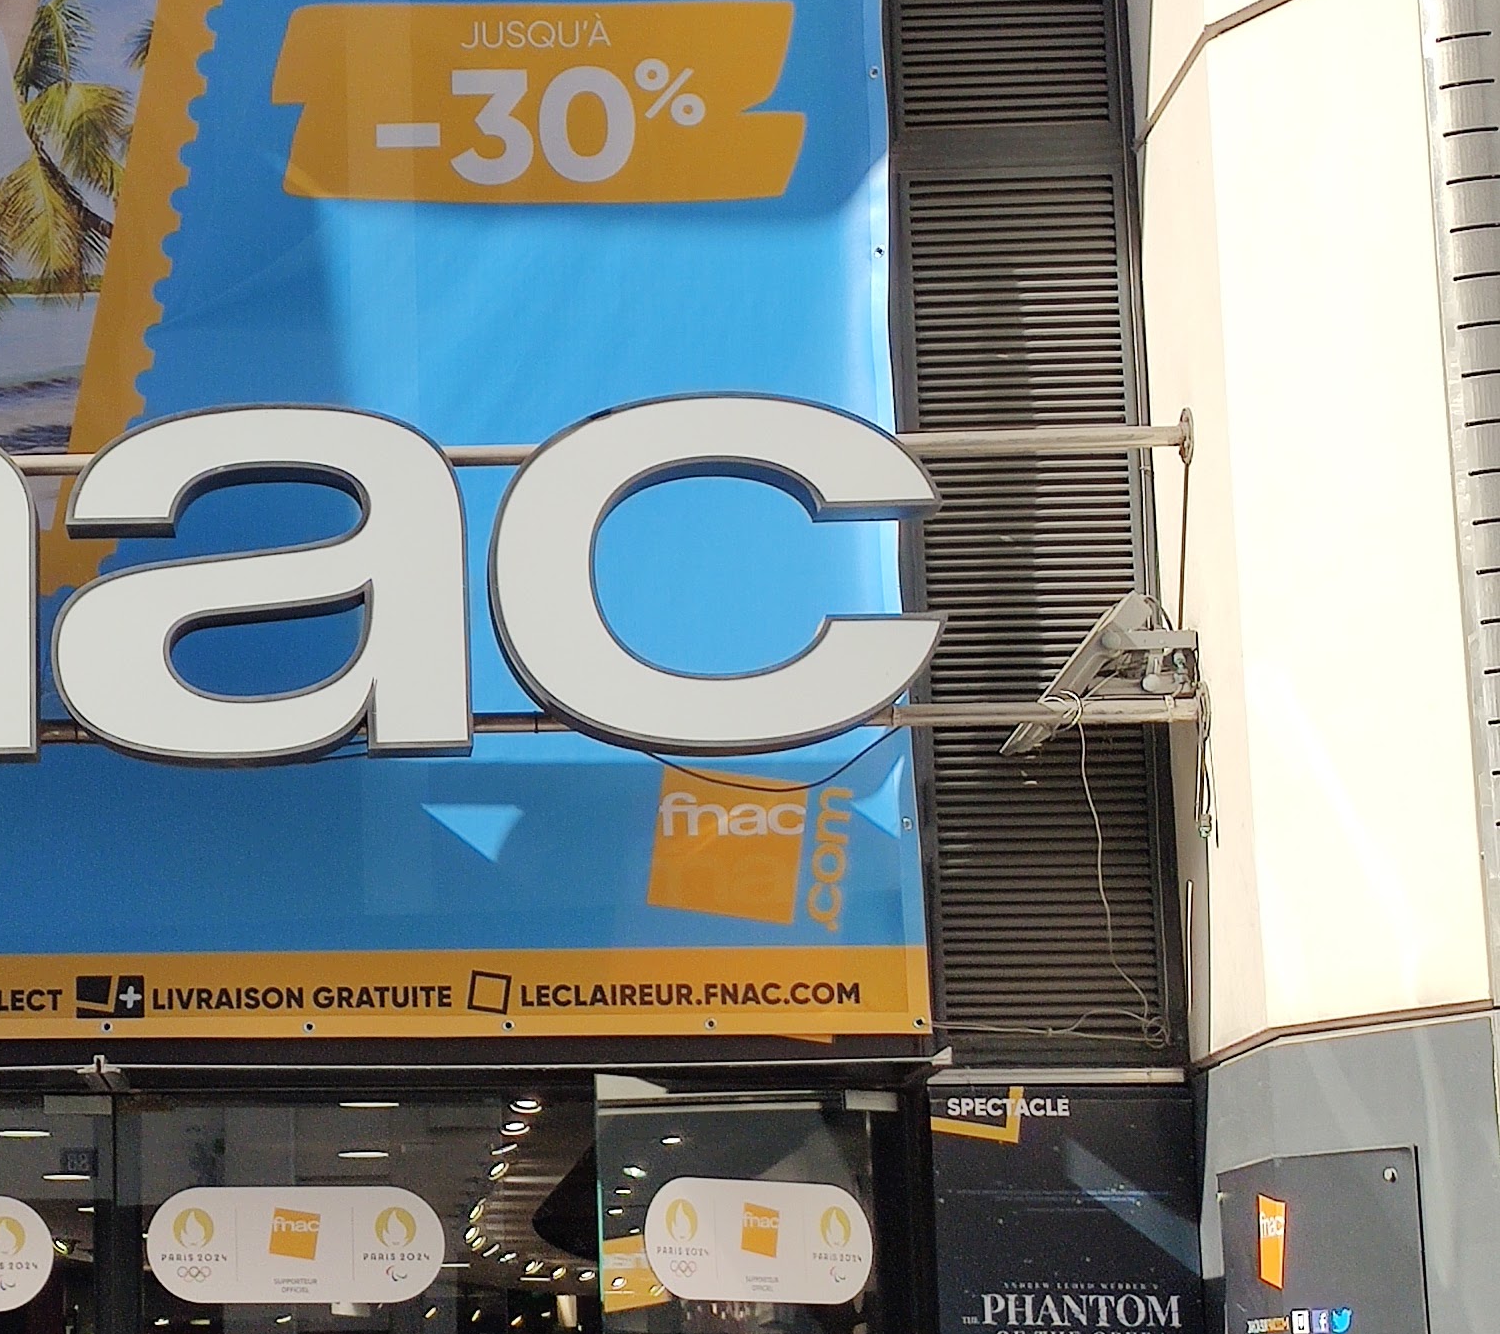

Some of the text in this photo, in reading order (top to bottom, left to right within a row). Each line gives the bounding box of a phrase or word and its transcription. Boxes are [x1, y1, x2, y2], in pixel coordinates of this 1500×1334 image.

[460, 13, 612, 50] JUSQU'À
[375, 58, 706, 186] -30%
[658, 791, 807, 837] fnac
[151, 985, 305, 1011] LIVRAISON
[312, 983, 453, 1010] GRATUITE
[519, 980, 861, 1008] LECLAIREUR.FNAC.COM
[947, 1097, 1070, 1117] SPECTACLE
[272, 1216, 320, 1233] fnac
[742, 1211, 779, 1230] fnac
[1259, 1211, 1285, 1238] fnac
[363, 1252, 396, 1261] PARIS
[981, 1293, 1182, 1328] PHANTOM
